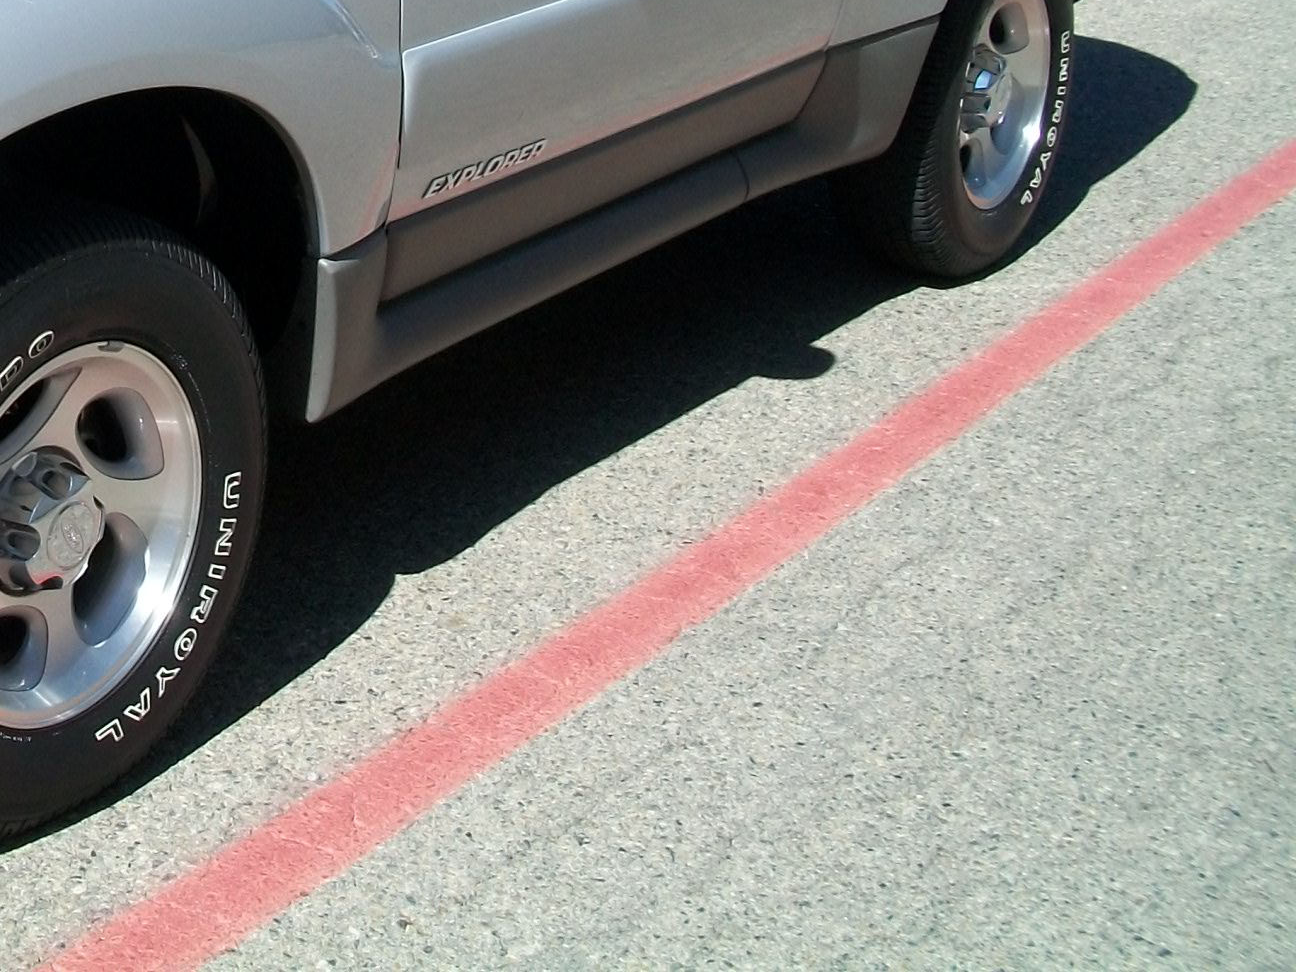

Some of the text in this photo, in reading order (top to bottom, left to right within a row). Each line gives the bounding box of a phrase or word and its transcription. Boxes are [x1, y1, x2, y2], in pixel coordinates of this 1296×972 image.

[421, 137, 547, 199] EXPLORER
[1020, 30, 1070, 205] UNIROYAL
[94, 471, 243, 742] UNIROYAL
